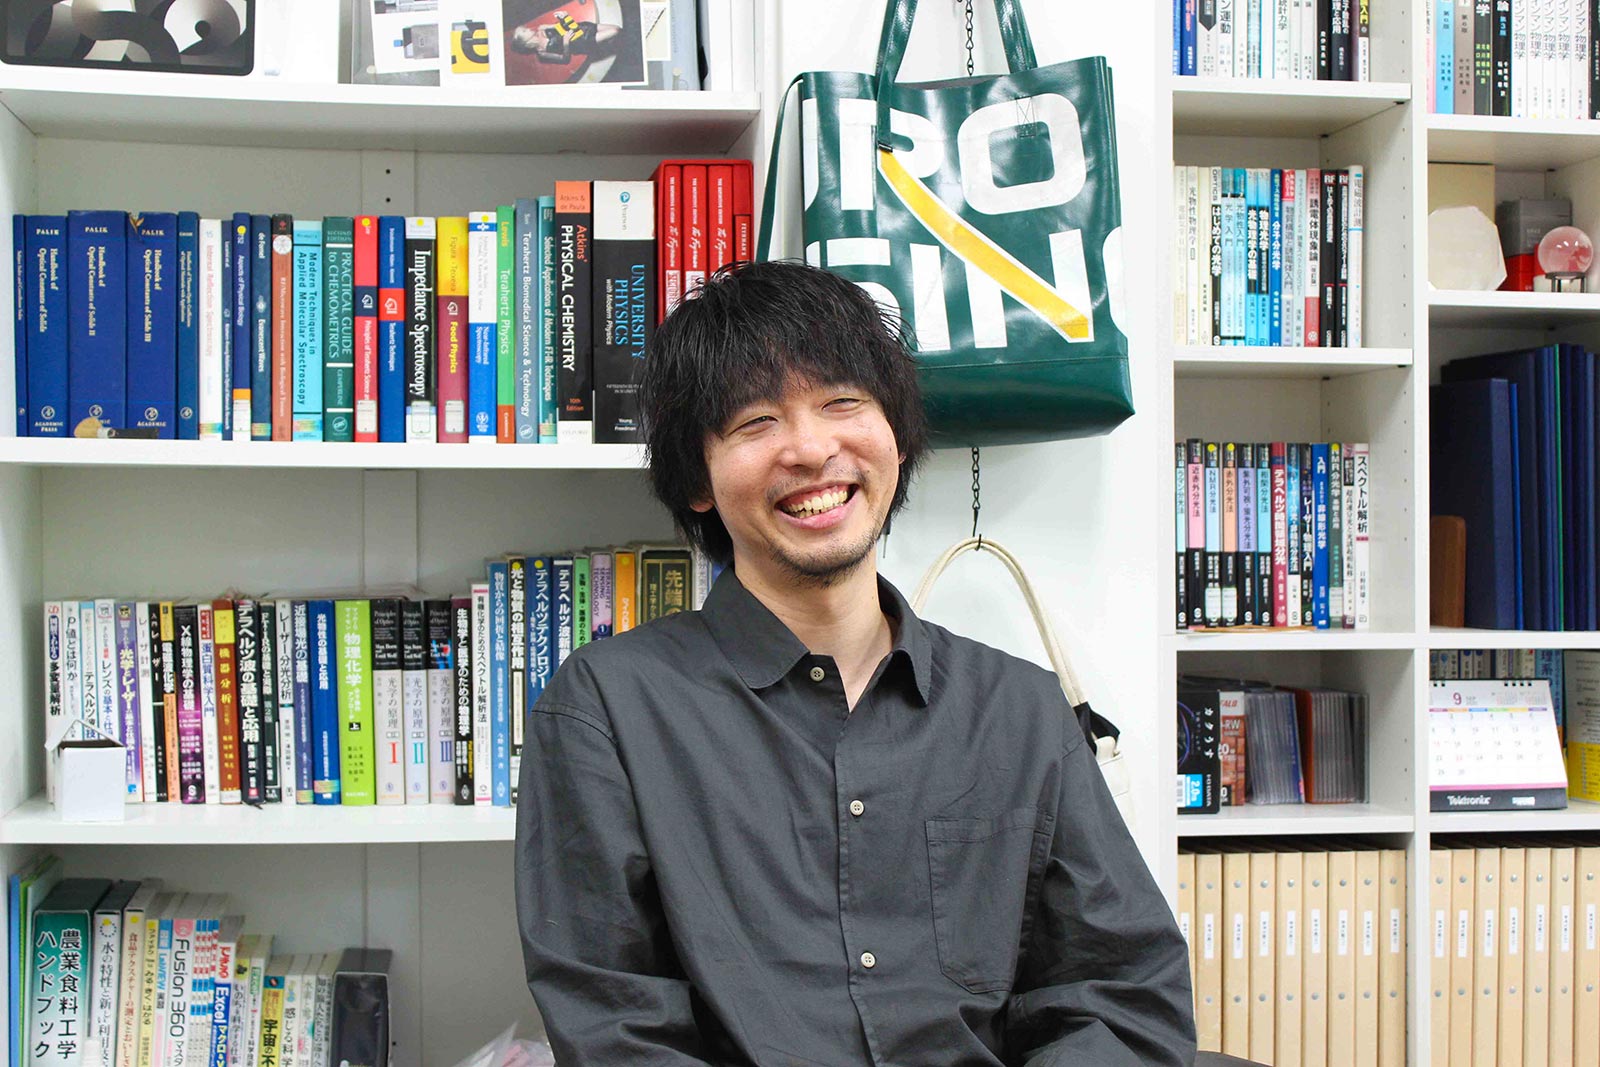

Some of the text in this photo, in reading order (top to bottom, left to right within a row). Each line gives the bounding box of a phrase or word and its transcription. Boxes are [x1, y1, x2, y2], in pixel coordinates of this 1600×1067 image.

[802, 93, 1087, 214] RO
[501, 221, 509, 247] Lewis
[523, 232, 531, 274] Terahertz
[544, 236, 553, 264] Selected
[1212, 206, 1222, 277] はじめての光学
[1310, 198, 1318, 262] 誘電体現象論
[50, 248, 58, 290] Handbook of
[88, 246, 96, 270] Optical
[98, 278, 105, 286] of
[144, 249, 152, 273] Optical
[38, 248, 47, 332] Optical Constants of Solids
[88, 272, 96, 301] Constants
[144, 275, 152, 304] Constants
[154, 282, 161, 290] of
[308, 253, 317, 354] Modern Techniques in
[329, 252, 339, 358] to CHEMOMETRICS
[342, 252, 351, 354] PRACTICAL GUIDE
[408, 250, 432, 320] Impedance
[523, 276, 531, 322] Biomedical
[543, 267, 553, 307] Applications
[561, 225, 574, 370] PHYSICAL CHEMISTRY
[88, 311, 96, 329] Solids
[144, 314, 152, 332] Solids
[298, 252, 307, 405] Applied Molecular Spectroscopy
[499, 269, 510, 354] Terahertz Physics
[545, 318, 553, 345] Modern
[615, 279, 628, 344] PHYSICS
[631, 264, 644, 359] UNIVERSITY
[409, 324, 429, 397] Spectroscopy
[449, 321, 458, 373] Food Physics
[523, 325, 531, 356] Science
[545, 346, 553, 362] FT-IR
[521, 368, 531, 416] Technology
[543, 365, 554, 401] Techniques
[1192, 466, 1200, 518] 近赤外分光法
[1357, 456, 1368, 534] スペクトル解析
[294, 604, 308, 683] 近接場光の基礎
[511, 569, 524, 669] 光と物質の相互作用
[536, 569, 549, 688] テラヘルツテクノロジー
[181, 625, 195, 710] X線物理学の基礎
[219, 648, 232, 704] 機器分析
[238, 605, 260, 743] テラヘルツ波の基礎と応用
[280, 613, 291, 700] レーザー分光分析
[344, 632, 362, 687] 物理化学
[457, 608, 470, 737] 生物学と医学のための物理学
[387, 676, 398, 728] 光学の原理
[413, 676, 423, 728] 光学の原理
[441, 676, 451, 726] 光学の原理
[1453, 692, 1461, 705] 9
[1447, 795, 1491, 805] Tektronix
[172, 939, 190, 997] Fusion
[35, 932, 58, 1059] ハンドブック
[57, 929, 81, 1060] 農業食料工学
[170, 1001, 186, 1037] 360
[216, 987, 229, 1024] Excel
